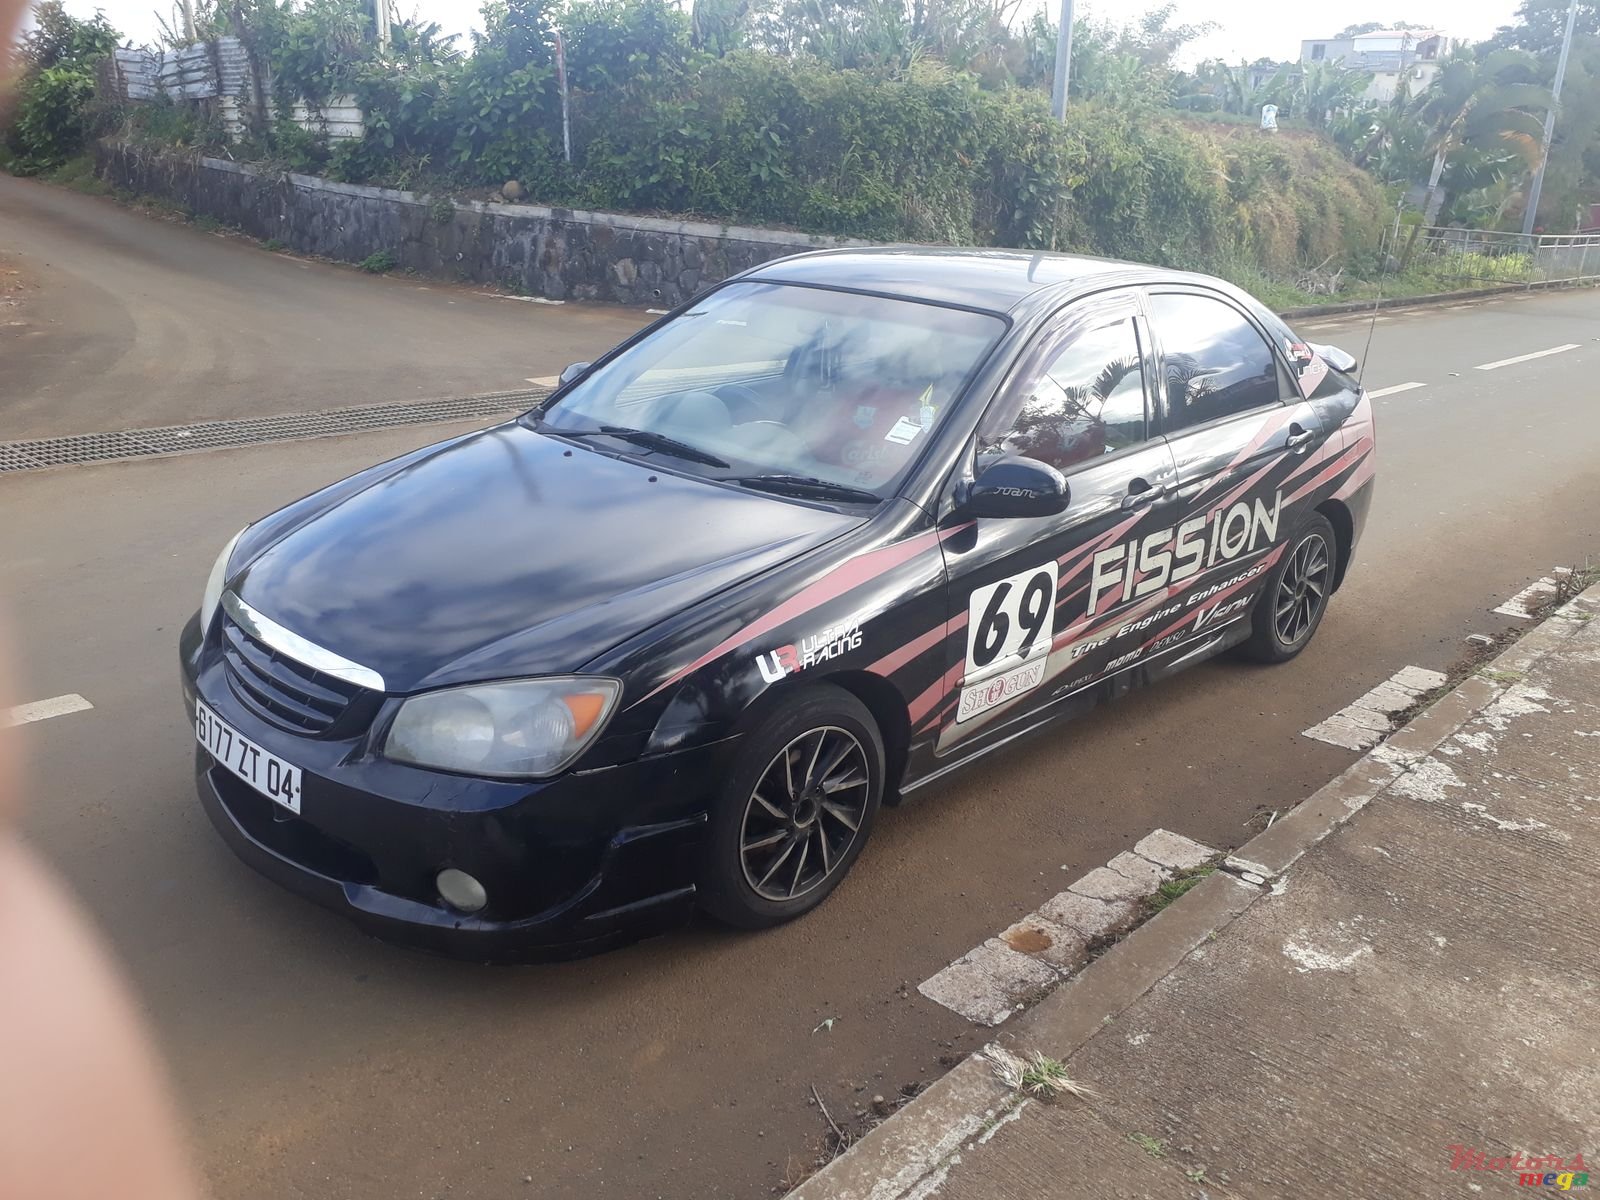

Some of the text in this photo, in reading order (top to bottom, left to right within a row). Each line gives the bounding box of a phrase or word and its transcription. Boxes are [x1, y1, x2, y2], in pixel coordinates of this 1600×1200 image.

[1086, 490, 1282, 617] FISSION
[801, 619, 859, 653] ULTRA
[803, 631, 862, 670] RACING
[973, 571, 1053, 668] 69
[1071, 564, 1265, 659] The Engine Enhancer
[961, 664, 1041, 716] SHOGUN
[198, 706, 294, 804] 6177 ZT 04
